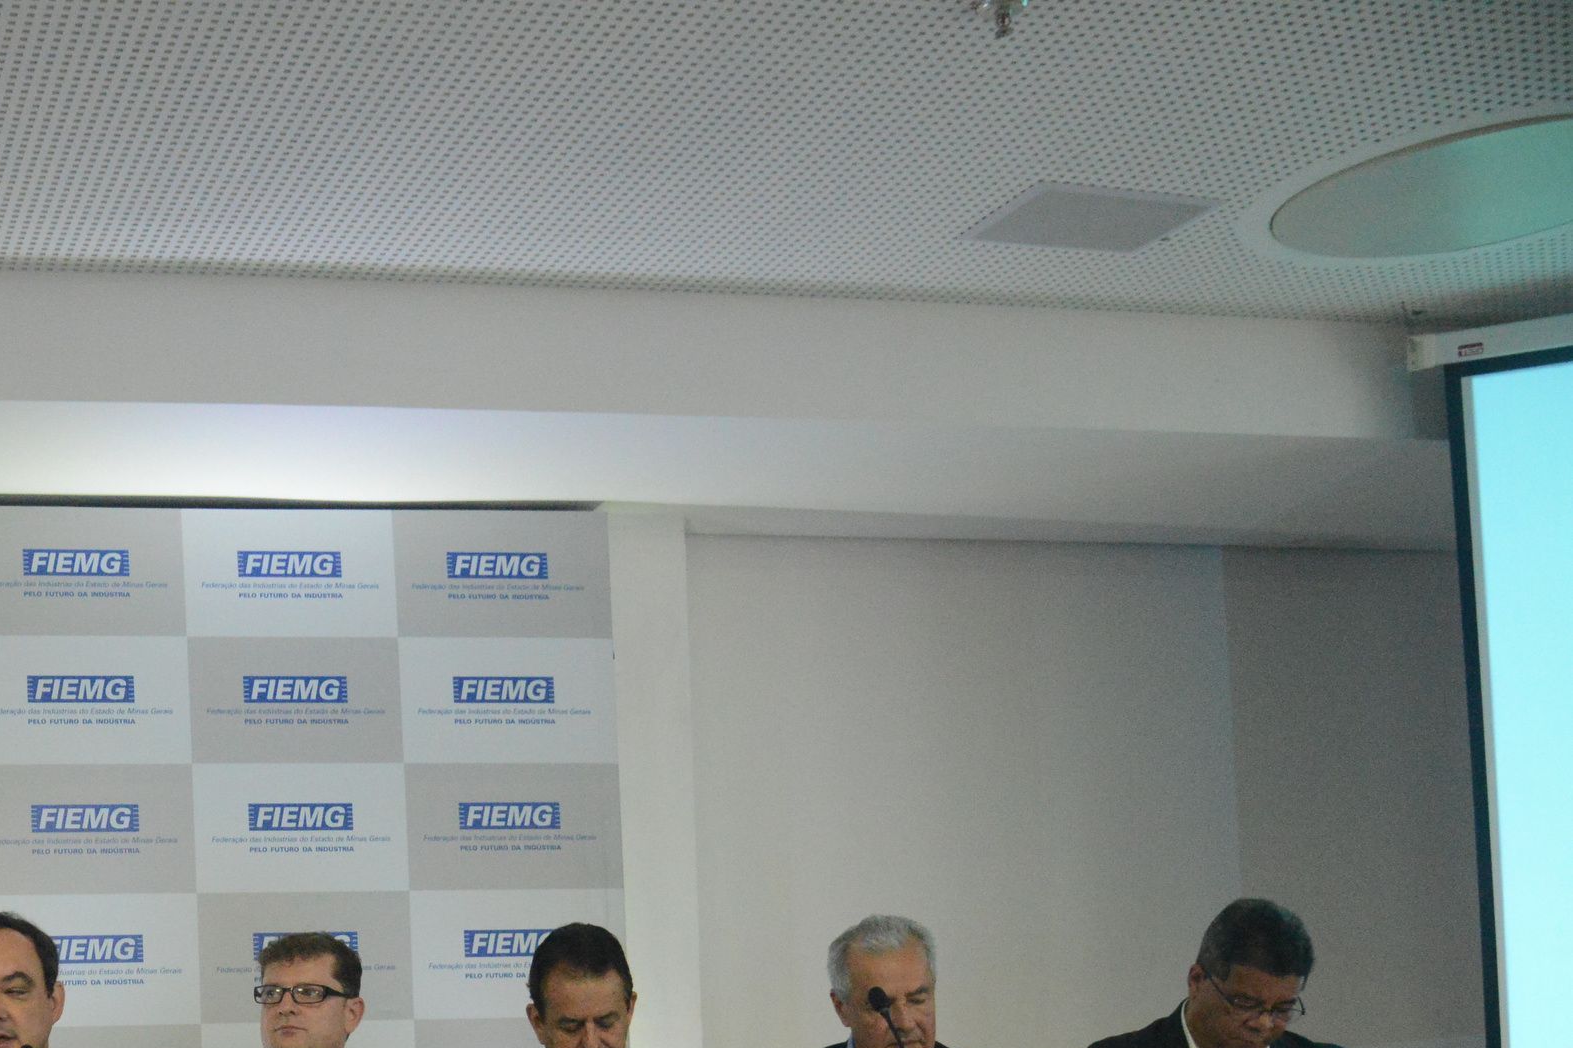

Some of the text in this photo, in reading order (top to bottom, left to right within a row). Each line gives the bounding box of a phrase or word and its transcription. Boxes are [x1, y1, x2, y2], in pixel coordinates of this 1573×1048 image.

[30, 552, 121, 574] FIEMG
[245, 554, 334, 575] FIEMG
[454, 555, 541, 576] FIEMG
[35, 679, 127, 700] FIEMG
[251, 679, 340, 700] FIEMG
[460, 679, 547, 701] FIEMG
[39, 807, 131, 830] FIEMG
[256, 806, 345, 828] FIEMG
[466, 805, 553, 827] FIEMG
[472, 932, 552, 954] FIEM
